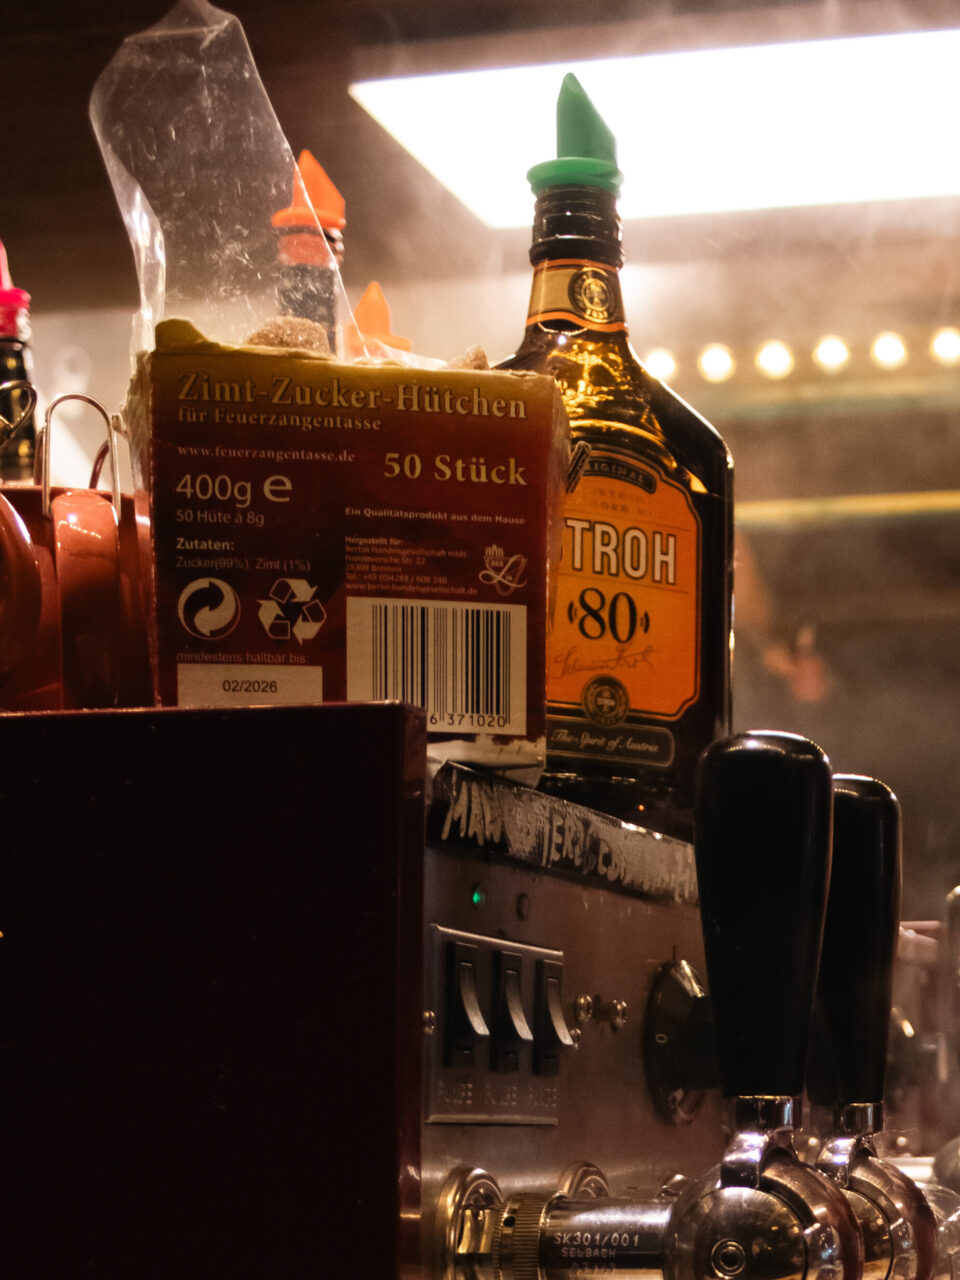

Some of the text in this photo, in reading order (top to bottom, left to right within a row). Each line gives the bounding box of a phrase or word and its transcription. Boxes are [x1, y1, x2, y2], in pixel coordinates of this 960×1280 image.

[177, 373, 527, 419] Zimt-Zucker-Hütchen
[178, 407, 383, 432] für Feuerzangentasse
[177, 445, 356, 463] www.feuerzangentasse.de
[383, 453, 528, 486] 50 Stück
[176, 474, 252, 508] 400g
[176, 509, 194, 523] 50
[197, 509, 232, 525] Hüte
[246, 511, 265, 528] 8g
[176, 537, 235, 551] Zutaten:
[561, 517, 677, 586] TROH
[578, 587, 637, 643] 80
[176, 650, 242, 663] mindestens
[246, 651, 286, 664] haltbar
[222, 679, 278, 693] 02/2026
[552, 1231, 640, 1247] SK301/001
